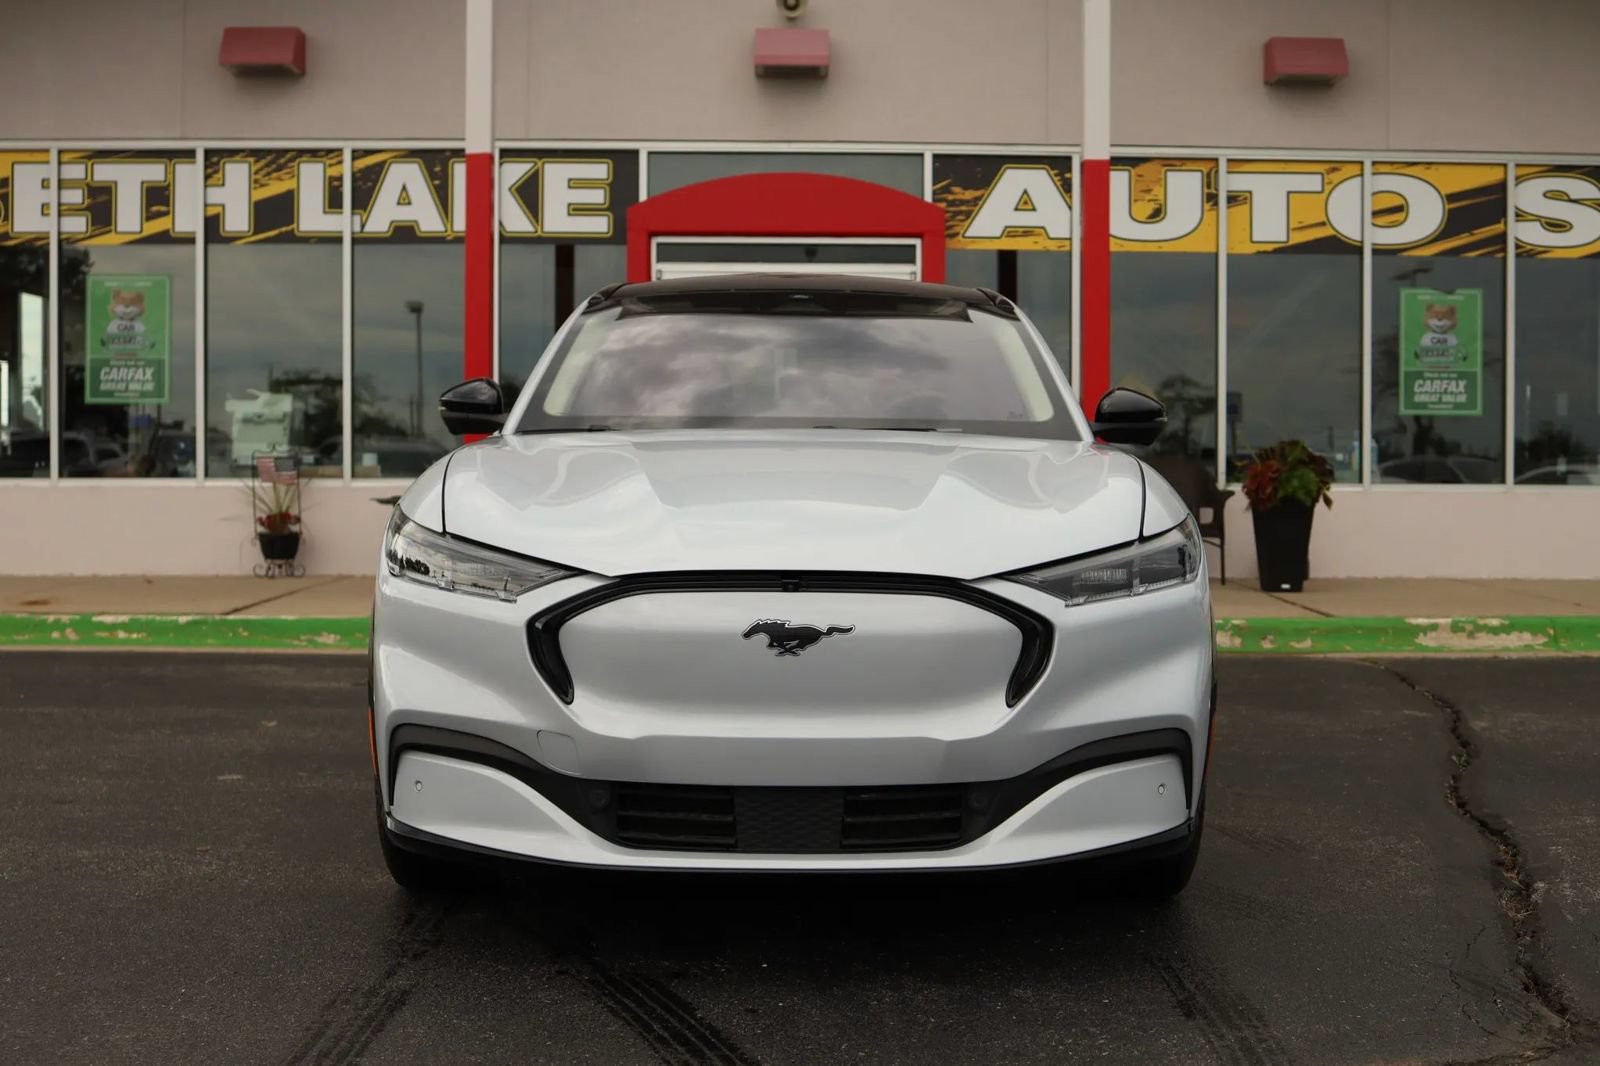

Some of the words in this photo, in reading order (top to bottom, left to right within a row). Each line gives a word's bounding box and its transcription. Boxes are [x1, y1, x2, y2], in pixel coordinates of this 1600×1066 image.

[0, 158, 254, 238] ETH
[296, 158, 614, 238] LAKE
[960, 163, 1448, 251] AUTO
[99, 366, 155, 381] CARFAX
[1413, 379, 1468, 393] CARFAX
